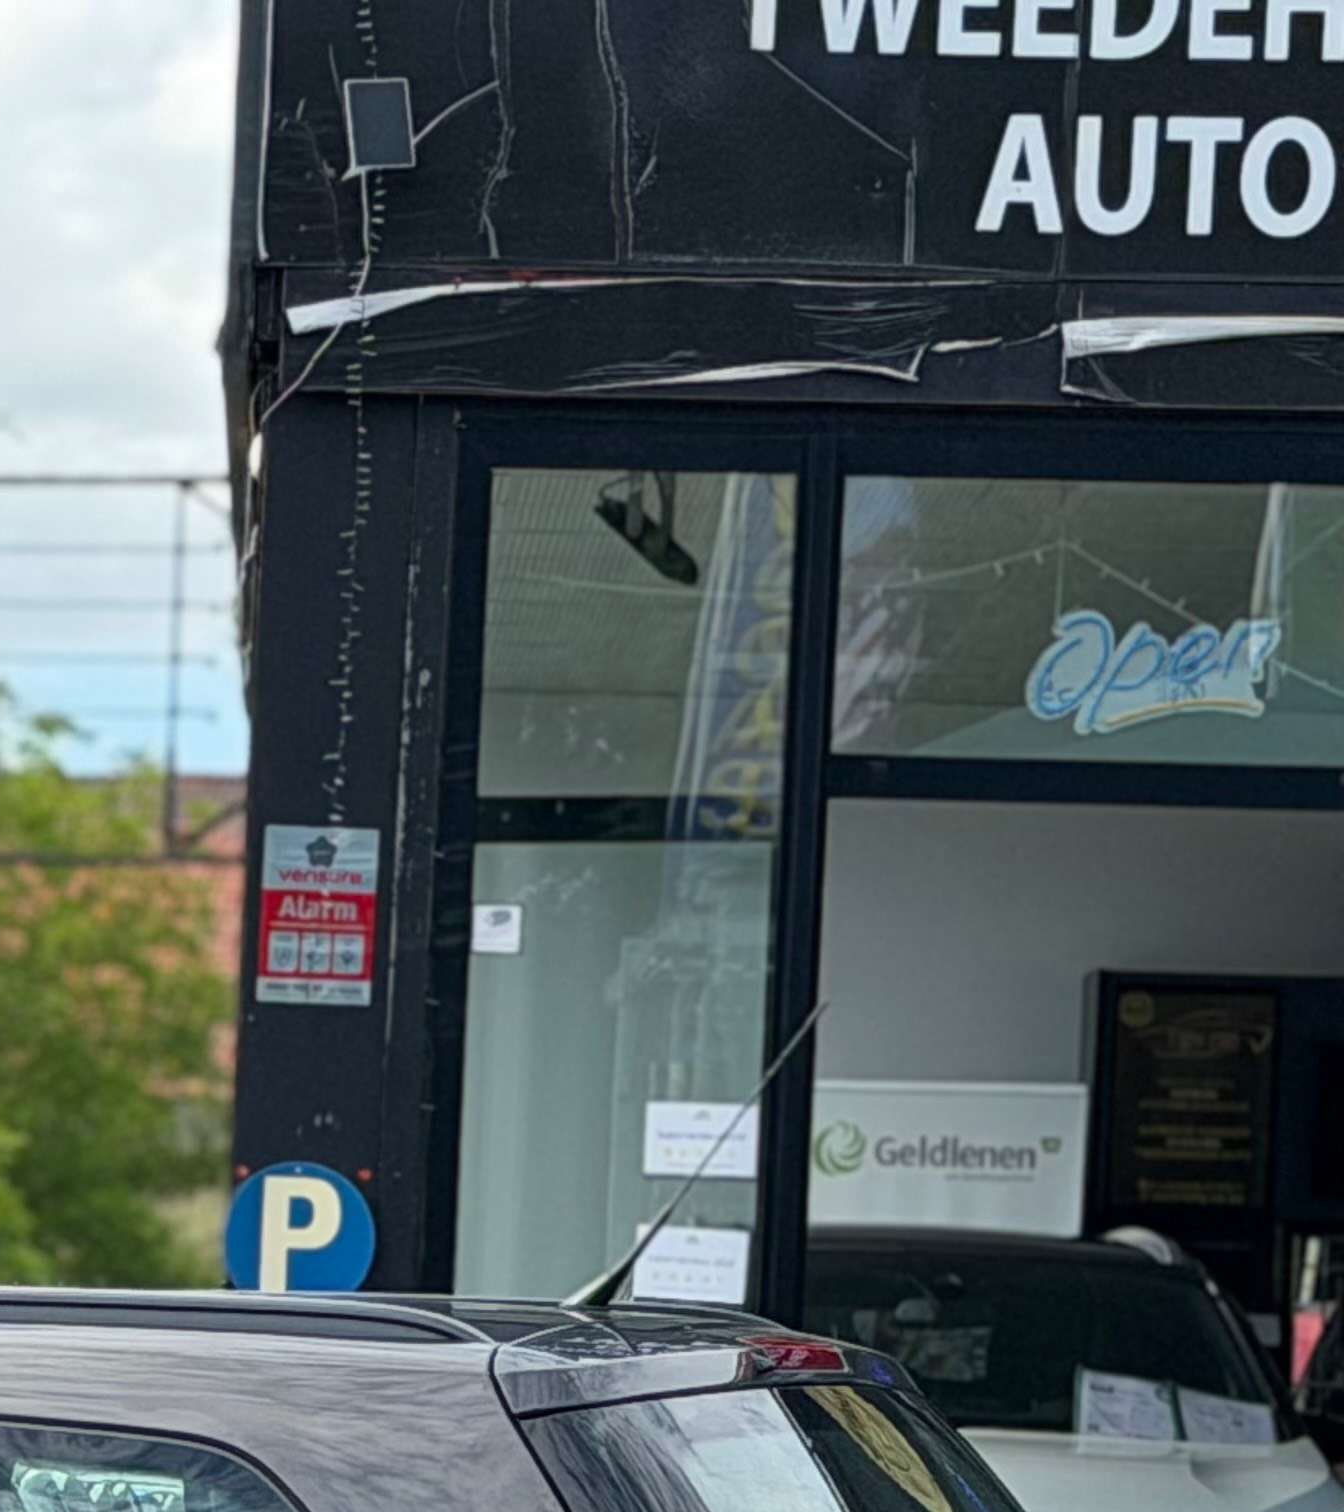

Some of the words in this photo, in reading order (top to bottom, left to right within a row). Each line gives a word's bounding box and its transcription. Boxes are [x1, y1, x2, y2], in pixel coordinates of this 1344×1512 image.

[974, 113, 1336, 239] AUTO
[1030, 612, 1279, 730] Open
[278, 894, 359, 922] Alarm
[873, 1135, 1037, 1170] Geldlenen
[259, 1174, 343, 1293] P
